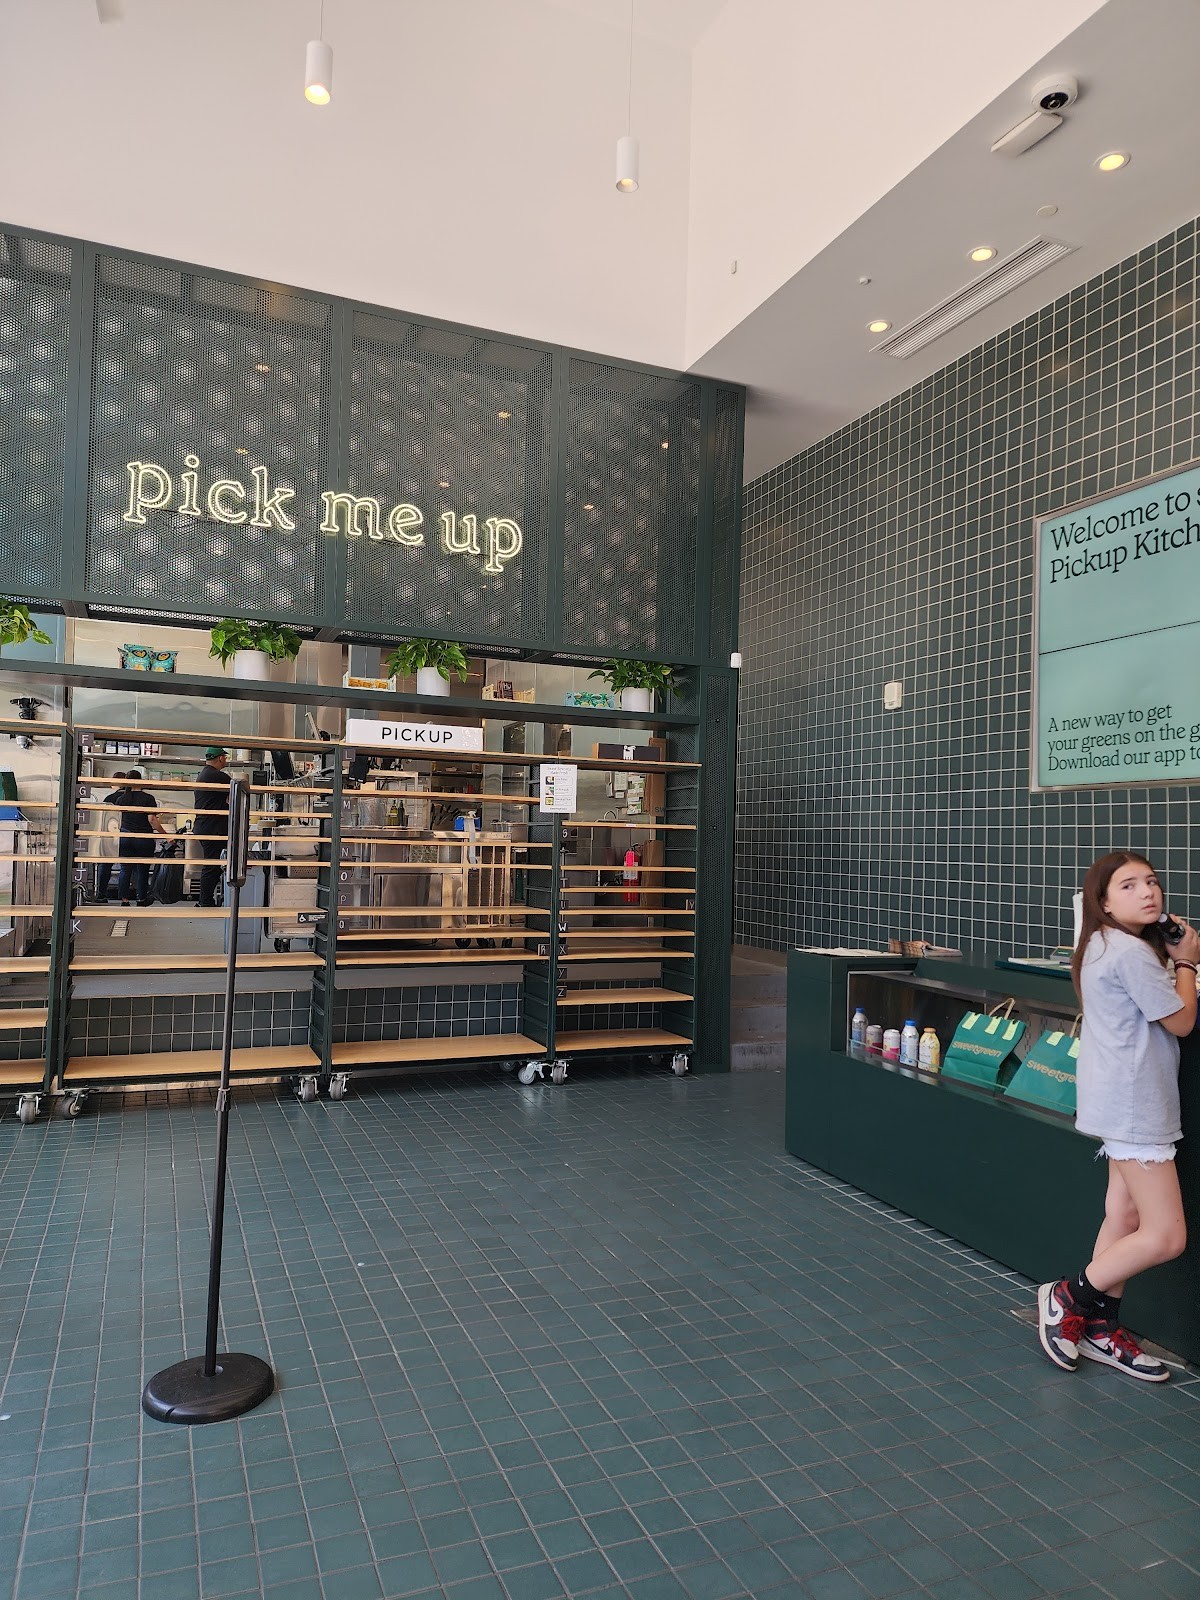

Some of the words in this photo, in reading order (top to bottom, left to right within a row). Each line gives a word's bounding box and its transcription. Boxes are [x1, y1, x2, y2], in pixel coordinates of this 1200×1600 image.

[123, 454, 295, 530] pick
[320, 491, 424, 545] me
[442, 511, 523, 572] up
[1050, 501, 1160, 551] Welcome
[1164, 491, 1191, 516] to
[1050, 545, 1128, 584] Pickup
[1048, 717, 1059, 732] A
[1062, 717, 1091, 731] new
[1094, 712, 1125, 729] way
[1128, 709, 1144, 723] to
[1147, 704, 1172, 725] get
[81, 735, 89, 744] F
[381, 727, 453, 743] PICKUP
[1048, 738, 1079, 756] your
[1081, 732, 1131, 753] greens
[1134, 730, 1155, 743] on
[1159, 723, 1187, 741] the
[345, 750, 352, 760] L
[1048, 749, 1120, 771] Download
[1123, 751, 1151, 765] our
[1154, 748, 1186, 767] app
[79, 786, 86, 795] G
[343, 800, 351, 809] M
[77, 812, 85, 822] H
[75, 840, 86, 851] I
[341, 847, 349, 857] N
[74, 869, 87, 881] J
[72, 919, 82, 933] K
[558, 922, 567, 931] W
[559, 945, 567, 954] X
[557, 988, 565, 997] Z
[952, 1040, 1003, 1058] sweetgreen
